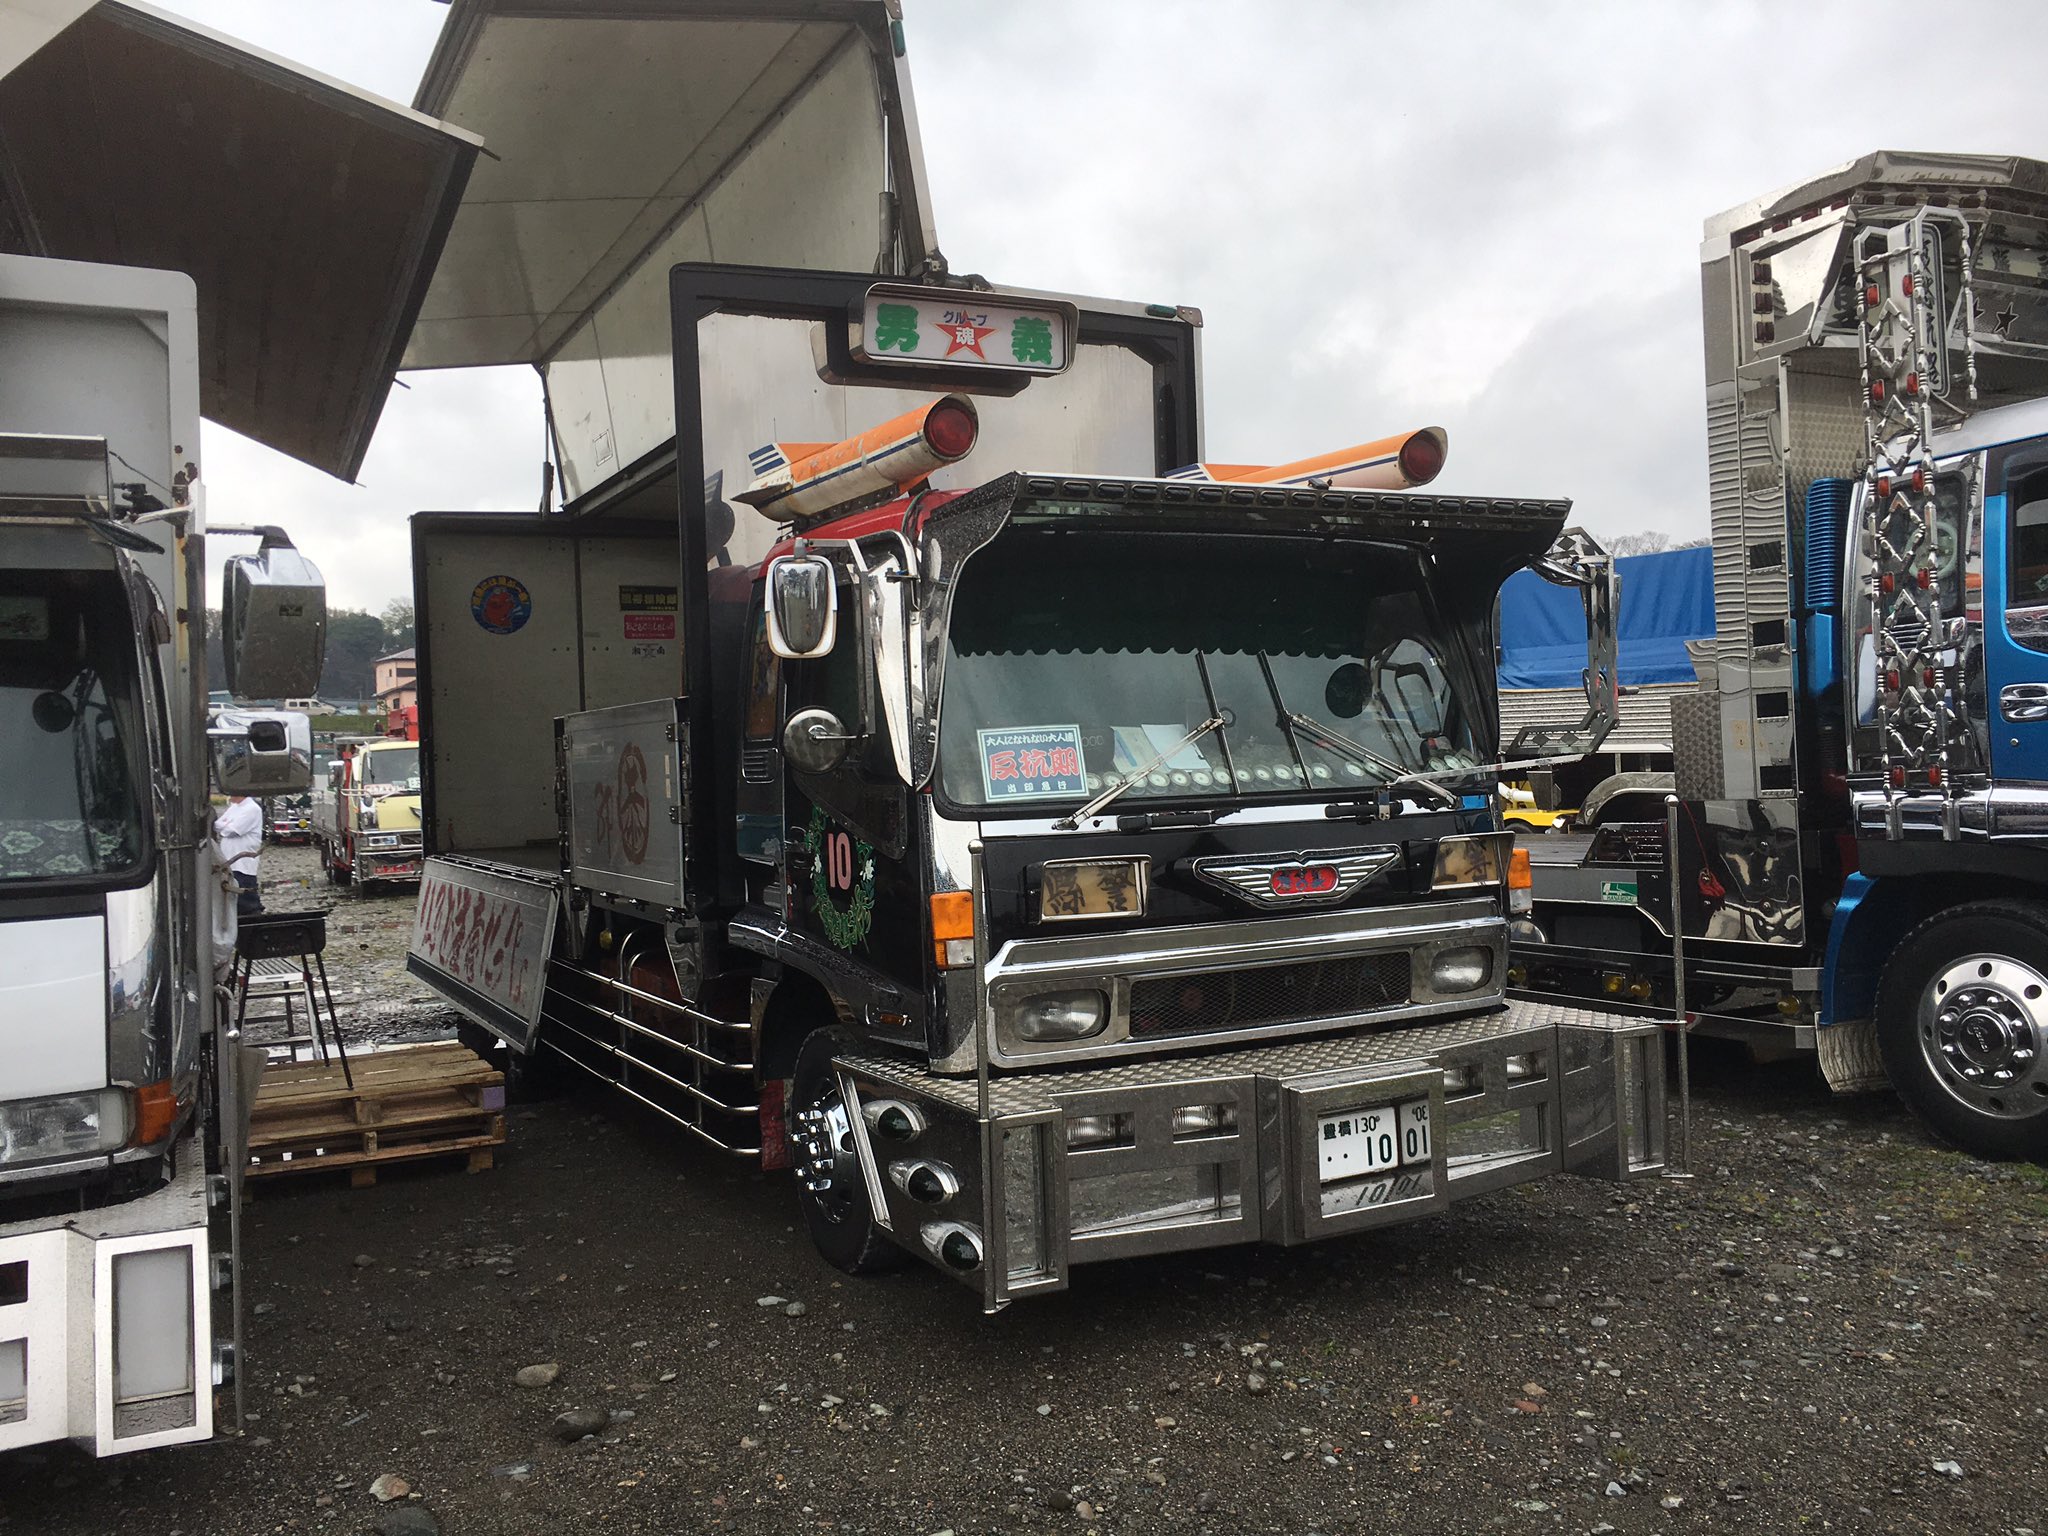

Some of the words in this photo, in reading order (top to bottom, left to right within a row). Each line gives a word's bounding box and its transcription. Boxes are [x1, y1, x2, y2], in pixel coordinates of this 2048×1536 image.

[943, 309, 989, 327] グループ
[875, 302, 921, 353] 男
[955, 326, 976, 347] 魂
[1010, 316, 1053, 365] 義
[985, 731, 1075, 747] 大人になれない大人達
[988, 746, 1080, 781] 反抗期
[827, 832, 852, 890] 10
[1323, 1120, 1352, 1140] 豊橋
[1355, 1115, 1378, 1134] 130
